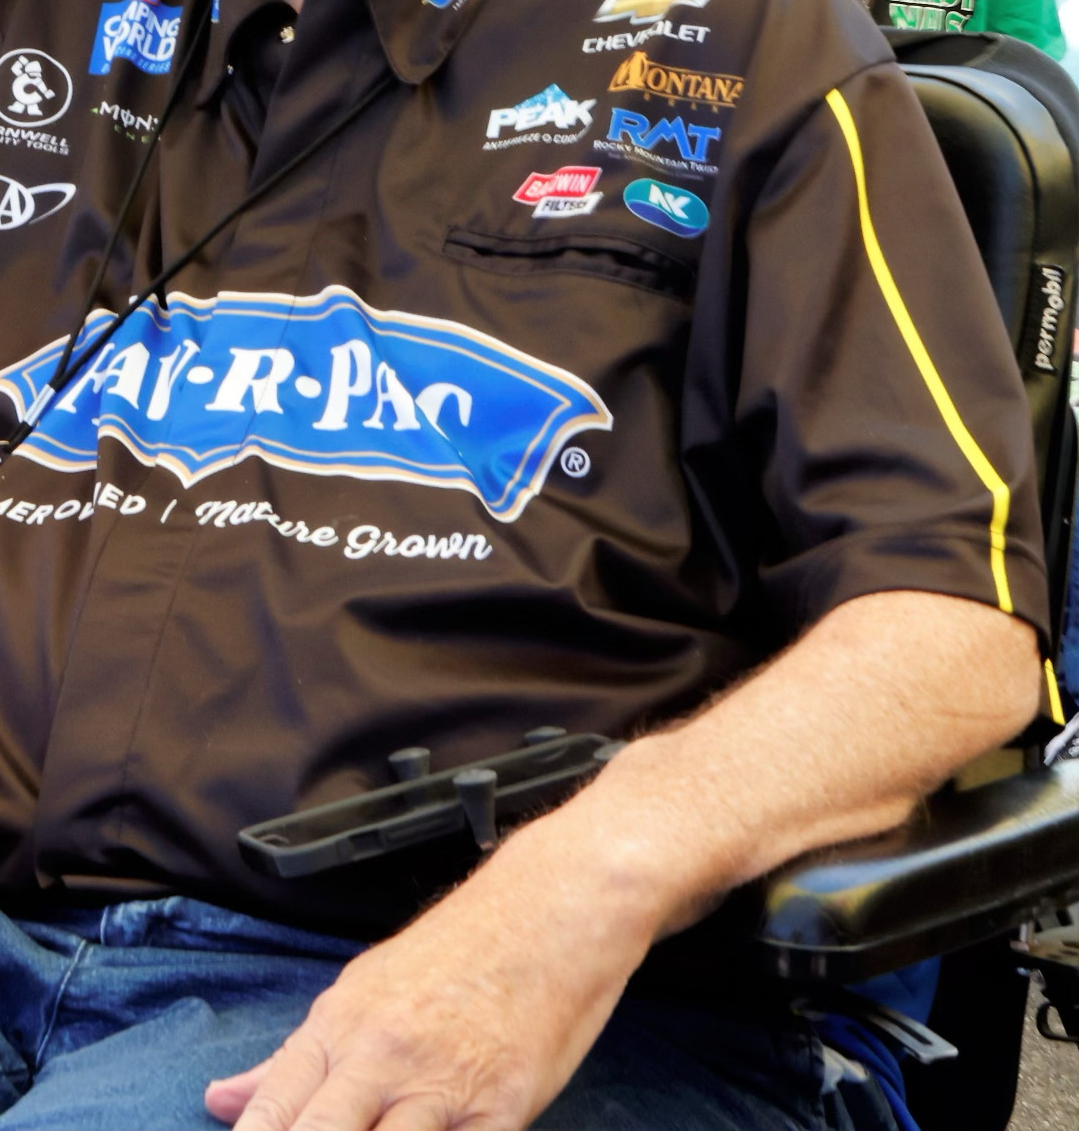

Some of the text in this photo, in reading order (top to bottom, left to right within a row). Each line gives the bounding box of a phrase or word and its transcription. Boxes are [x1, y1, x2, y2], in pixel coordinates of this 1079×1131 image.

[485, 99, 597, 139] PEAK
[607, 107, 721, 162] RMT
[1034, 267, 1066, 371] permobil
[343, 524, 494, 560] Grown
